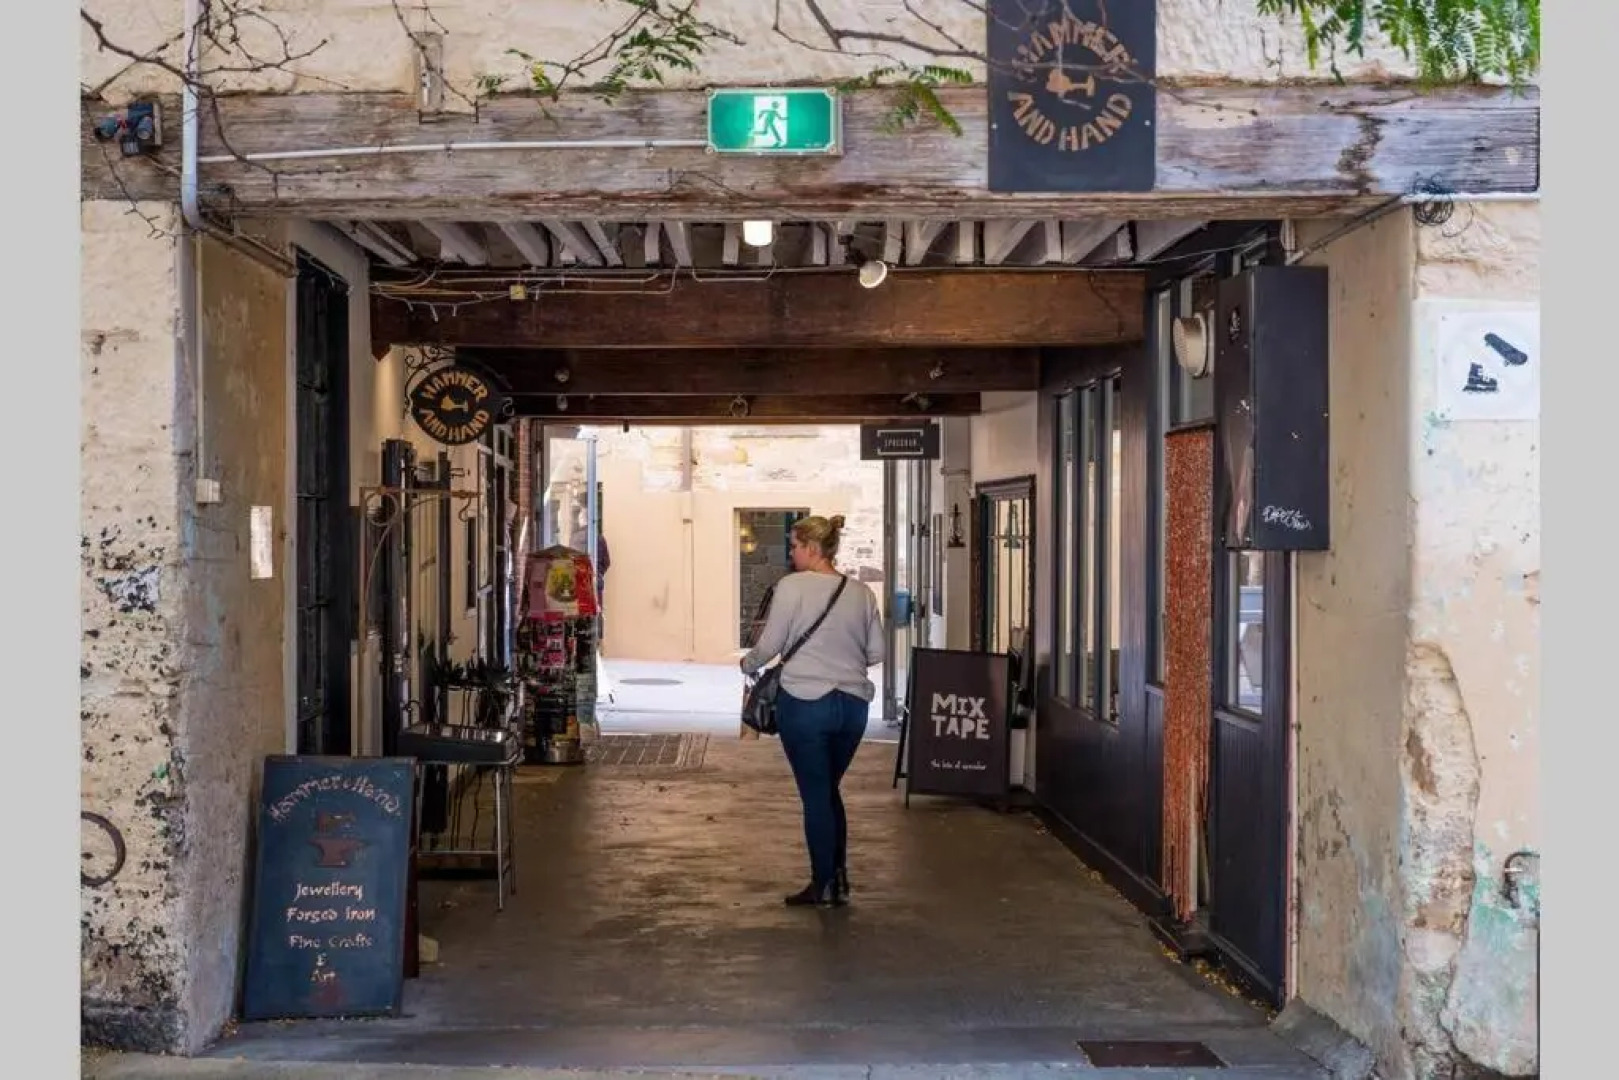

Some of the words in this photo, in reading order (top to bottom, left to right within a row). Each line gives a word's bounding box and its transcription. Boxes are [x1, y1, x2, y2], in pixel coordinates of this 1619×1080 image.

[1011, 19, 1132, 83] HAMMER
[1006, 91, 1056, 145] AND
[1058, 93, 1133, 152] HAND
[420, 371, 488, 404] HAMMER
[419, 409, 448, 437] AND
[448, 410, 490, 442] HAND
[931, 693, 987, 719] MIX
[930, 714, 991, 740] TAPE
[293, 881, 364, 902] Jewellery
[286, 907, 339, 924] Forged
